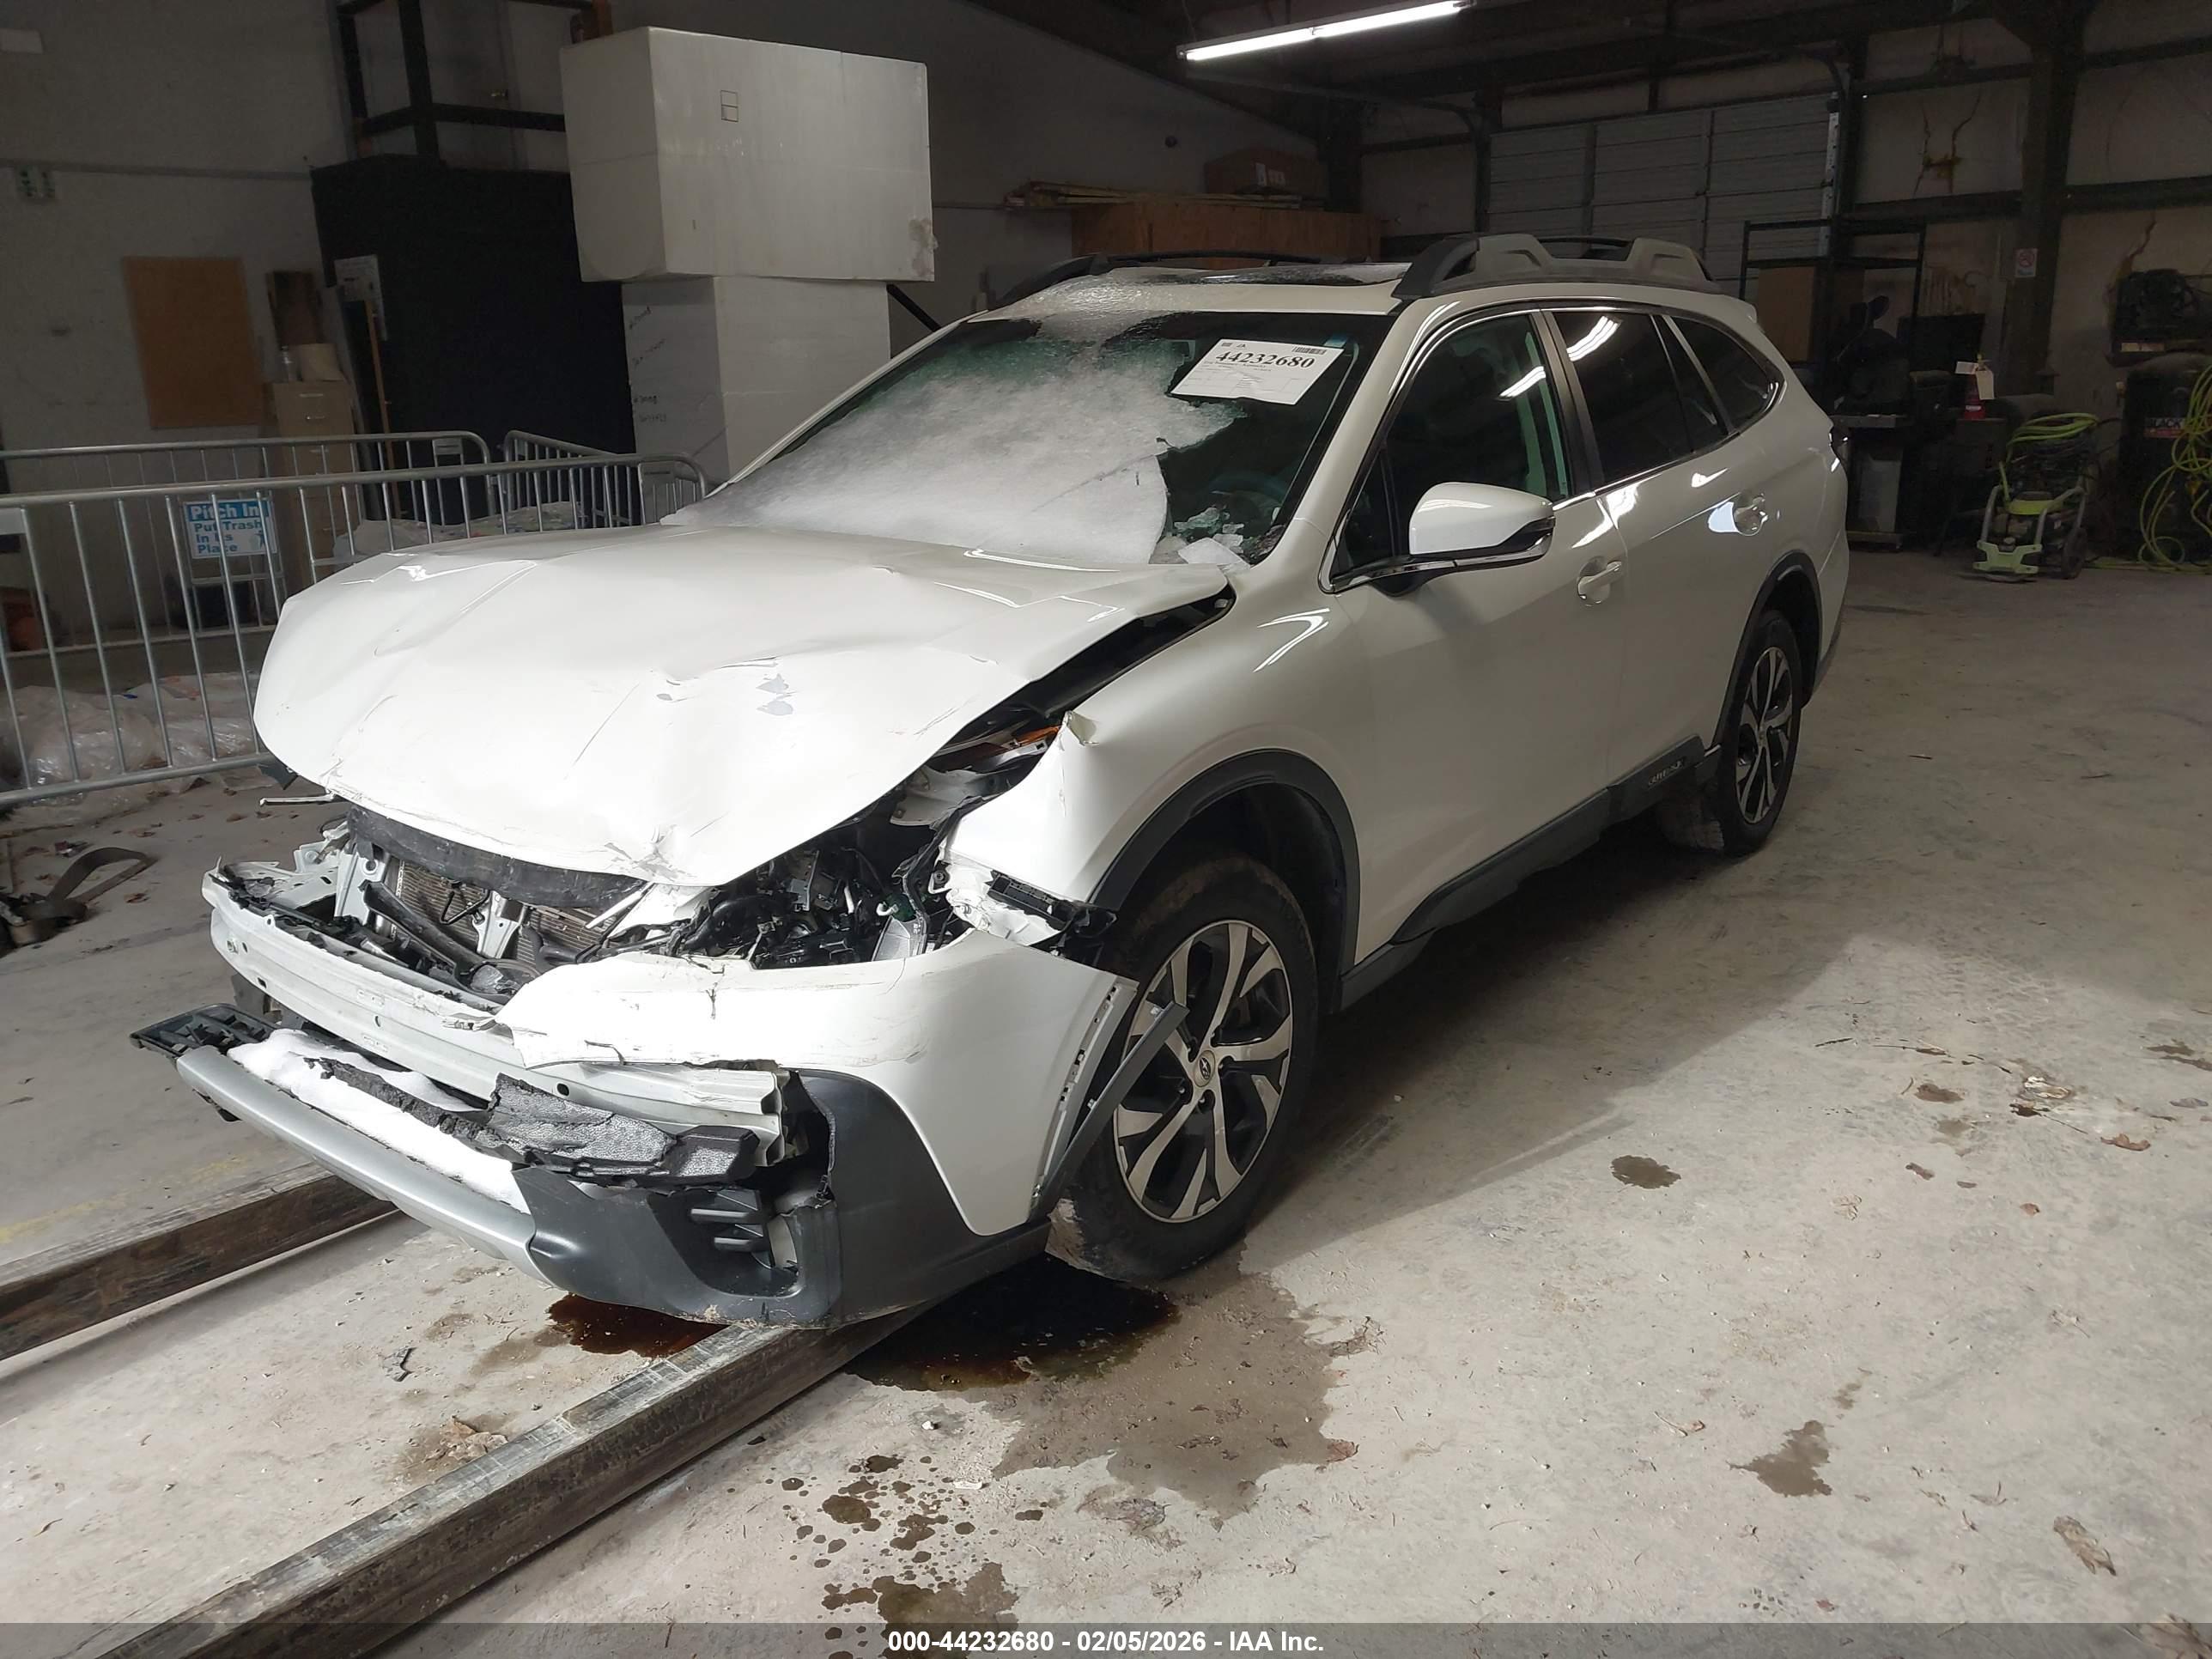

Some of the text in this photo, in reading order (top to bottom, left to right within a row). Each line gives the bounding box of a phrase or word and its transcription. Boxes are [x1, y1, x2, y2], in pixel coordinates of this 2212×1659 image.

[1215, 351, 1316, 368] 44232680
[191, 502, 260, 520] Pitch In
[194, 519, 263, 532] Put Trash
[196, 532, 234, 543] In Is
